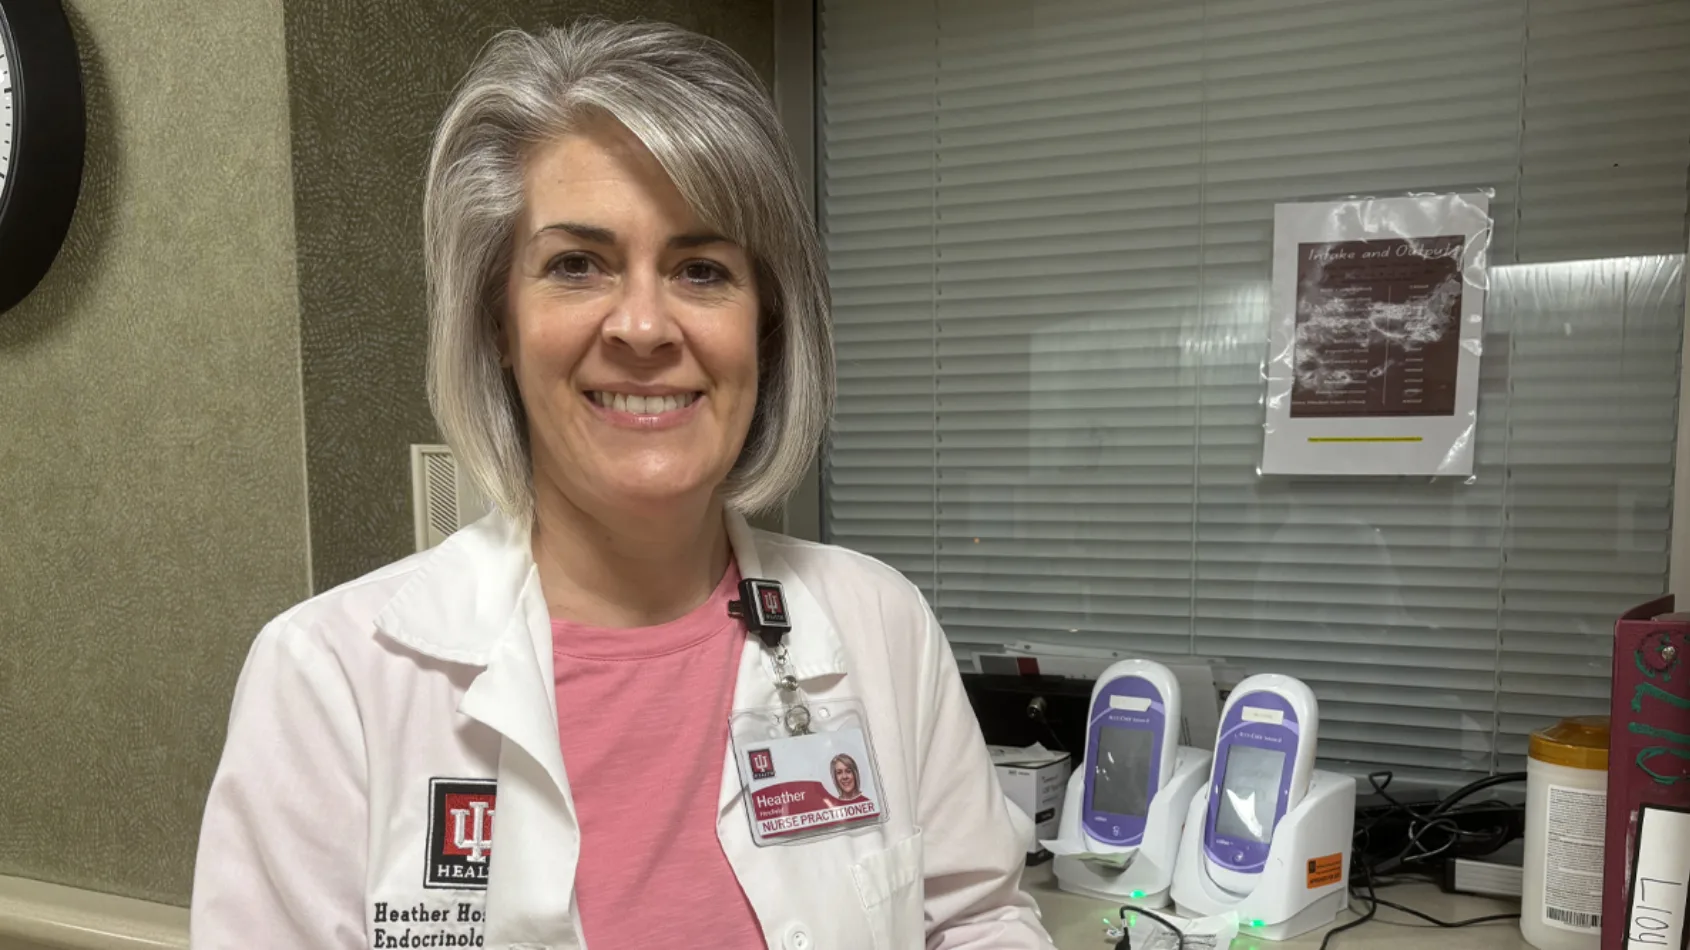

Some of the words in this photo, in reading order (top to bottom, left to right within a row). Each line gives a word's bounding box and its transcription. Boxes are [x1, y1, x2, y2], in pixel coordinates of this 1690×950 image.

[1308, 245, 1355, 261] Intake
[1362, 245, 1391, 258] and
[757, 790, 805, 808] Heather
[762, 817, 800, 833] NURSE
[800, 802, 875, 825] PRACTITIONER
[437, 864, 490, 878] HEAL
[374, 902, 450, 922] Heather
